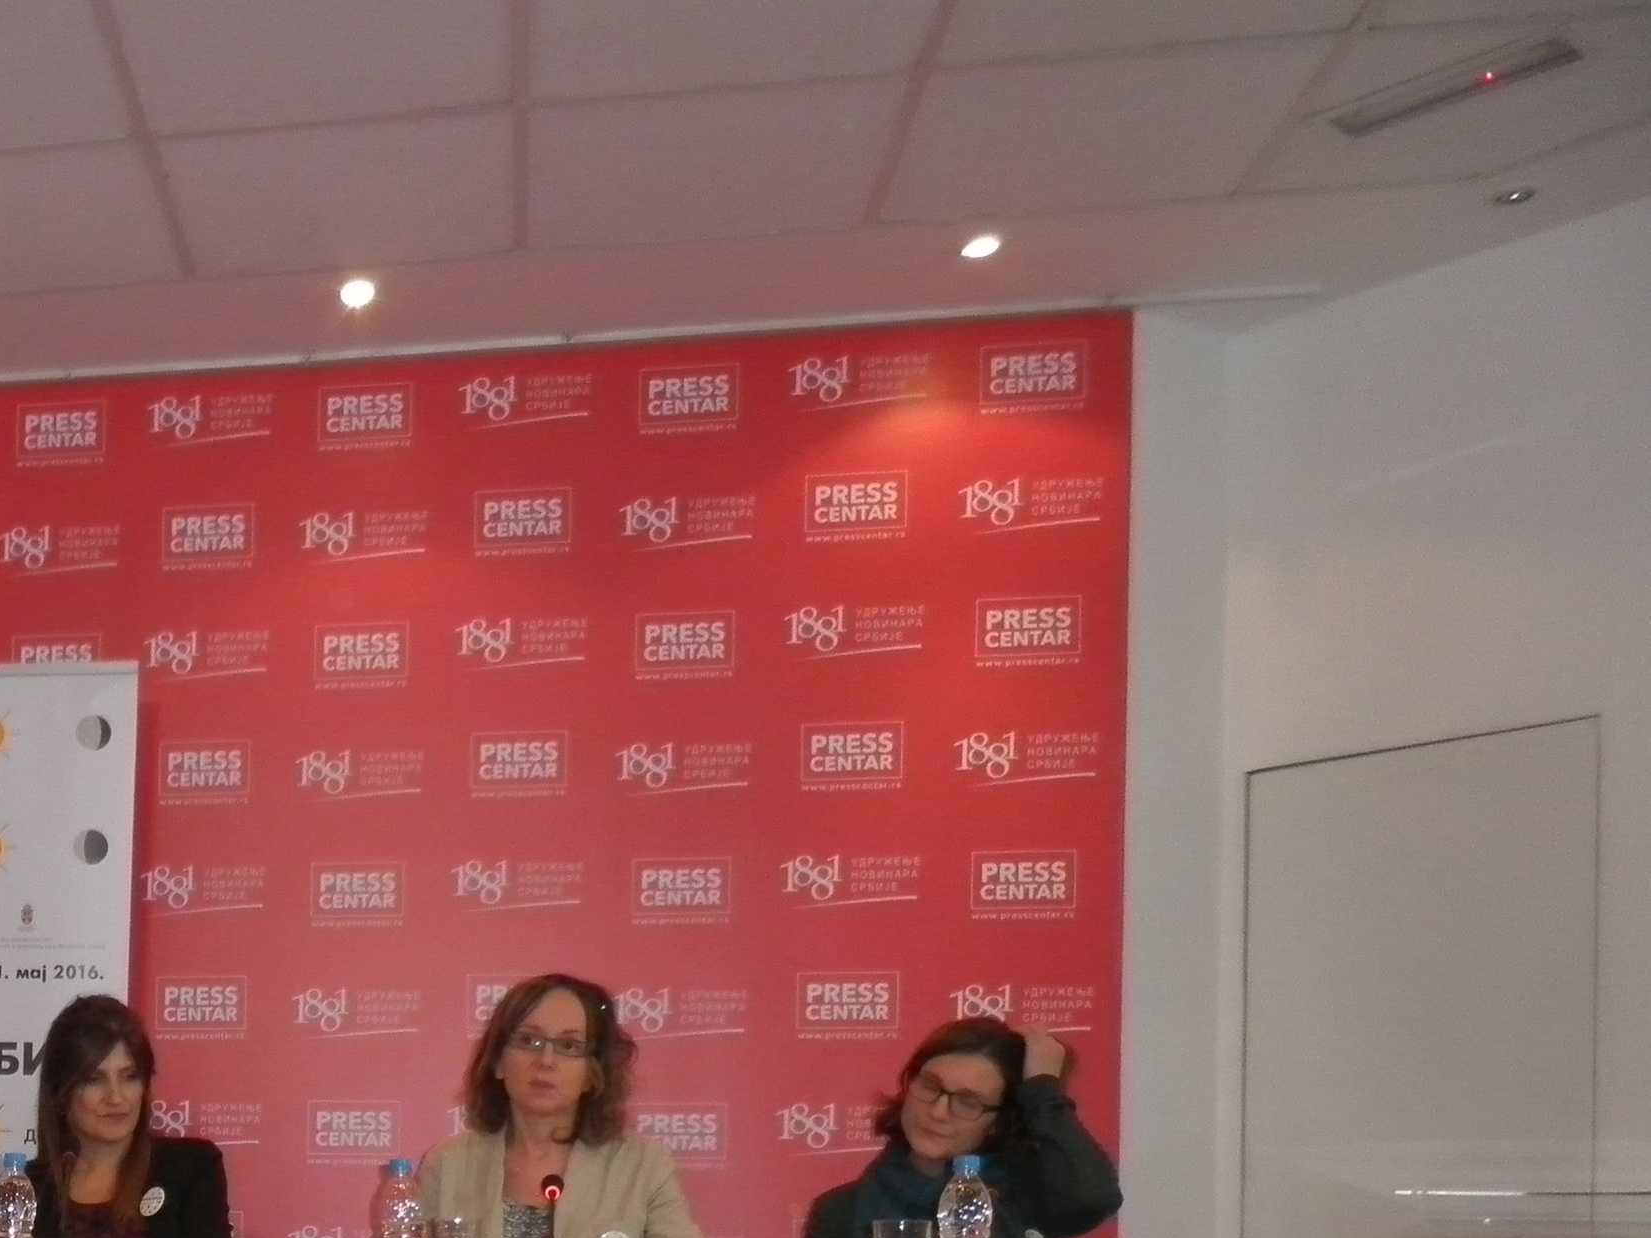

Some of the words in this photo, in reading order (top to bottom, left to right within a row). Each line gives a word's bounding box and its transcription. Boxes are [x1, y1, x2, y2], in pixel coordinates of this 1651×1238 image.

[991, 352, 1076, 376] PRESS
[649, 375, 729, 398] PRESS
[990, 373, 1075, 394] CENTAR
[328, 393, 403, 415] PRESS
[648, 395, 728, 415] CENTAR
[26, 412, 96, 432] PRESS
[327, 413, 402, 432] CENTAR
[25, 430, 96, 449] CENTAR
[816, 482, 897, 505] PRESS
[484, 499, 562, 520] PRESS
[815, 503, 897, 522] CENTAR
[172, 515, 245, 535] PRESS
[483, 518, 561, 537] CENTAR
[171, 534, 244, 552] CENTAR
[986, 608, 1071, 631] PRESS
[645, 622, 725, 645] PRESS
[985, 627, 1070, 647] CENTAR
[324, 633, 399, 654] PRESS
[644, 642, 724, 661] CENTAR
[323, 652, 399, 670] CENTAR
[480, 742, 557, 762] PRESS
[812, 733, 893, 756] PRESS
[169, 751, 241, 771] PRESS
[479, 760, 557, 779] CENTAR
[811, 754, 892, 771] CENTAR
[168, 770, 241, 787] CENTAR
[642, 869, 721, 891] PRESS
[982, 862, 1066, 882] PRESS
[321, 873, 395, 893] PRESS
[980, 881, 1065, 900] CENTAR
[319, 890, 395, 909] CENTAR
[641, 888, 720, 906] CENTAR
[16, 964, 47, 982] мај
[54, 965, 104, 980] 2016.
[165, 986, 237, 1005] PRESS
[807, 983, 888, 1003] PRESS
[164, 1004, 237, 1021] CENTAR
[806, 1004, 888, 1020] CENTAR
[317, 1112, 391, 1131] PRESS
[638, 1114, 716, 1133] PRESS
[316, 1129, 391, 1146] CENTAR
